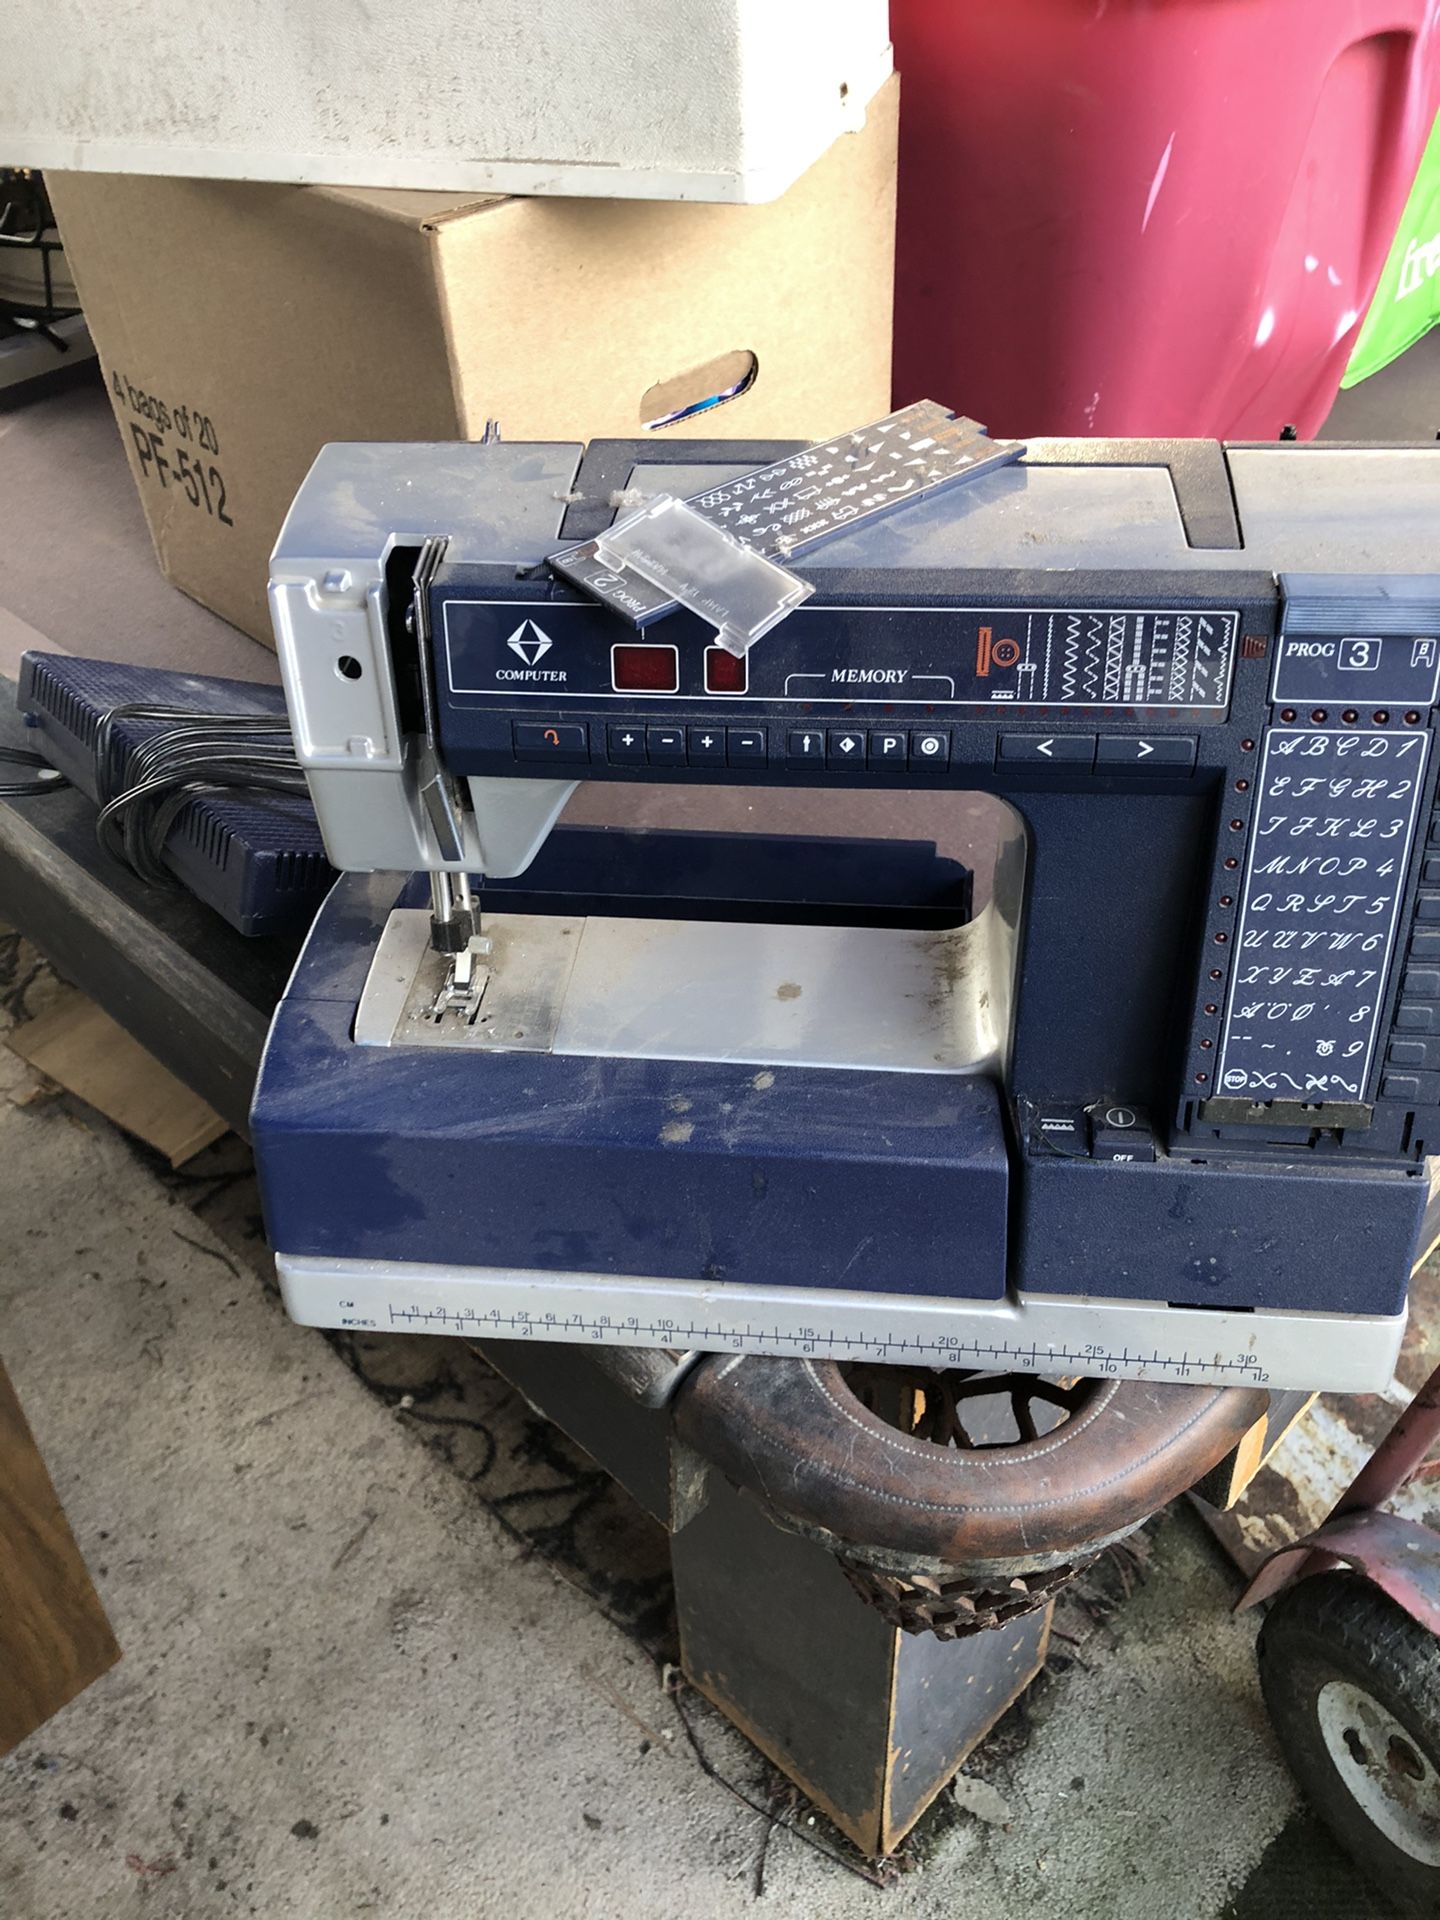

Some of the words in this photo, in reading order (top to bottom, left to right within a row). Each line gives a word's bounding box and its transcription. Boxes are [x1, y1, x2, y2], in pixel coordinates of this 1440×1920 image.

[112, 370, 126, 406] 4
[123, 375, 172, 434] bags
[173, 405, 193, 442] of
[193, 411, 219, 456] 20
[130, 422, 233, 527] PF-512
[594, 573, 618, 587] 2
[612, 590, 647, 613] PROG
[1286, 643, 1335, 656] PROG
[1350, 642, 1369, 666] 3
[496, 670, 566, 681] COMPUTER
[832, 670, 907, 683] MEMORY
[884, 738, 896, 753] P
[1271, 736, 1306, 755] A
[1300, 736, 1329, 755] B
[1361, 738, 1388, 756] D
[1386, 780, 1411, 798] 2
[1380, 819, 1403, 837] 3
[1376, 859, 1394, 876] 4
[1364, 896, 1390, 914] 5
[1361, 933, 1383, 951] 6
[1354, 971, 1376, 987] 7
[1349, 1006, 1370, 1022] 8
[1342, 1041, 1364, 1057] 9
[657, 1319, 674, 1329] 10
[799, 1327, 814, 1337] 15
[938, 1336, 958, 1346] 20
[1085, 1344, 1104, 1355] 25
[1237, 1354, 1257, 1365] 30
